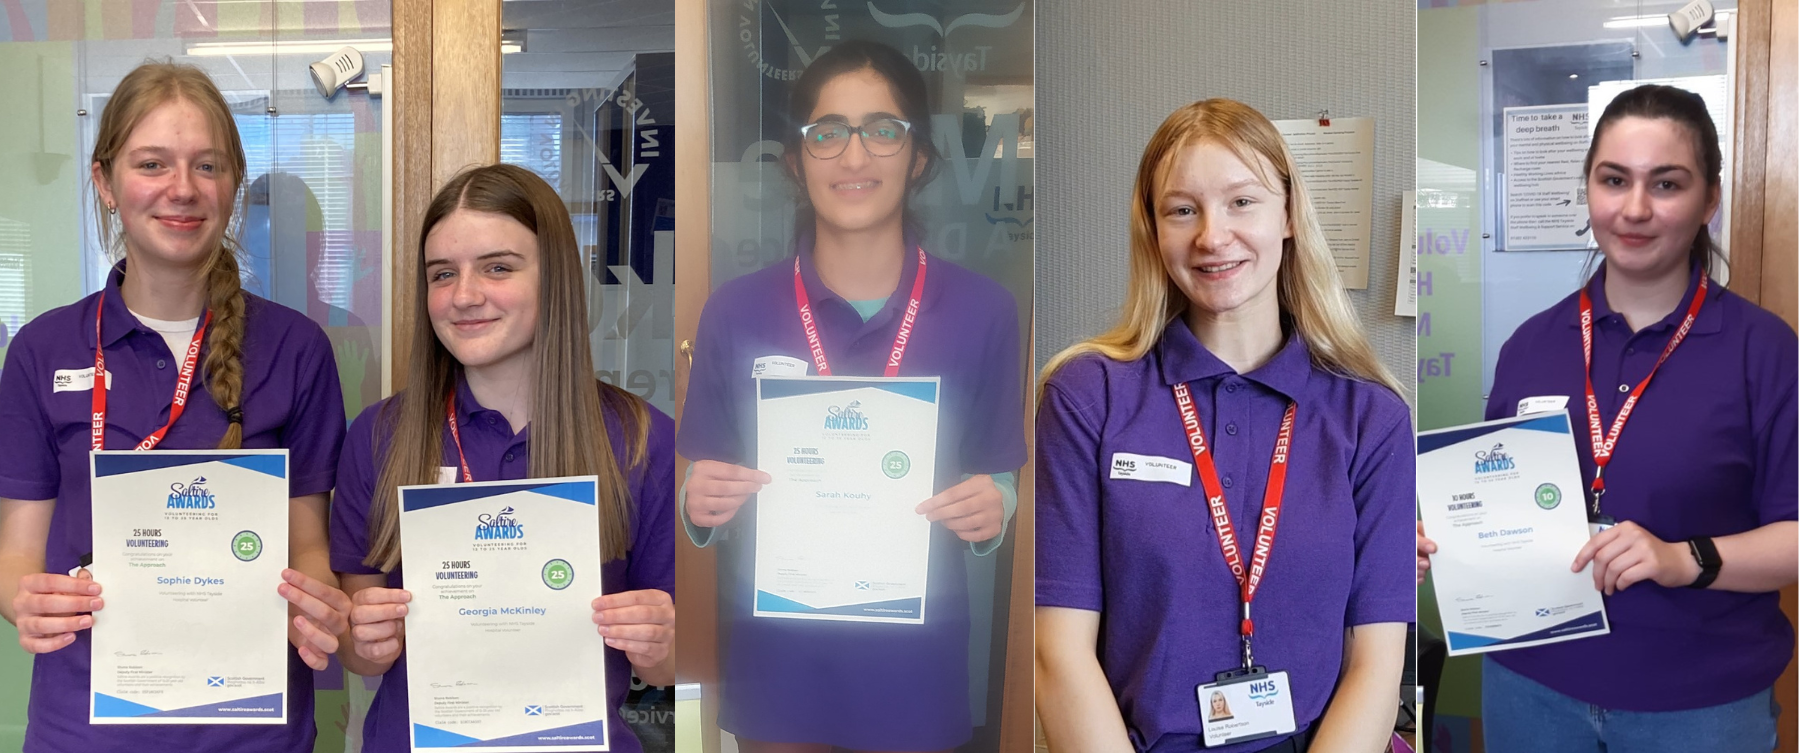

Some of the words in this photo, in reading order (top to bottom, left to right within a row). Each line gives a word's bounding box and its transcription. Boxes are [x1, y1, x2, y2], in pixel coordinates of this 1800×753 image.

[800, 304, 827, 372] VOLUNTEER
[889, 298, 919, 368] VOLUNTEER
[1658, 314, 1695, 364] OLUNTEER
[174, 339, 200, 406] VOLUNTEER
[824, 416, 868, 430] AWARDS
[1174, 382, 1206, 456] VOLUNTEER
[92, 412, 104, 450] NTEER
[1273, 401, 1295, 464] LUNTEER
[1588, 395, 1603, 458] VOLUNTEER
[1600, 396, 1638, 458] VOLUNTEER
[890, 460, 902, 469] 25
[1116, 460, 1135, 468] NHS
[1475, 457, 1515, 474] AWARDS
[170, 480, 210, 499] Saltire
[844, 492, 871, 501] Kouhy
[166, 494, 215, 509] AWARDS
[1447, 500, 1483, 511] VOLUNTEERING
[478, 512, 518, 530] Saltire
[142, 529, 162, 537] HOURS
[475, 524, 524, 540] AWARDS
[1478, 530, 1498, 539] Beth
[1500, 527, 1533, 536] Dawson
[126, 539, 169, 548] VOLUNTEERING
[241, 542, 254, 550] 25
[1210, 495, 1245, 586] VOLUNTEER
[1248, 507, 1277, 595] VOLUNTEER
[451, 560, 471, 569] HOURS
[157, 576, 191, 585] Sophie
[194, 577, 224, 586] Dykes
[435, 571, 478, 580] VOLUNTEERING
[551, 570, 564, 579] 25
[458, 607, 498, 617] Georgia
[500, 606, 546, 616] McKinley
[1250, 680, 1275, 694] NHS
[1256, 700, 1274, 708] Tayside
